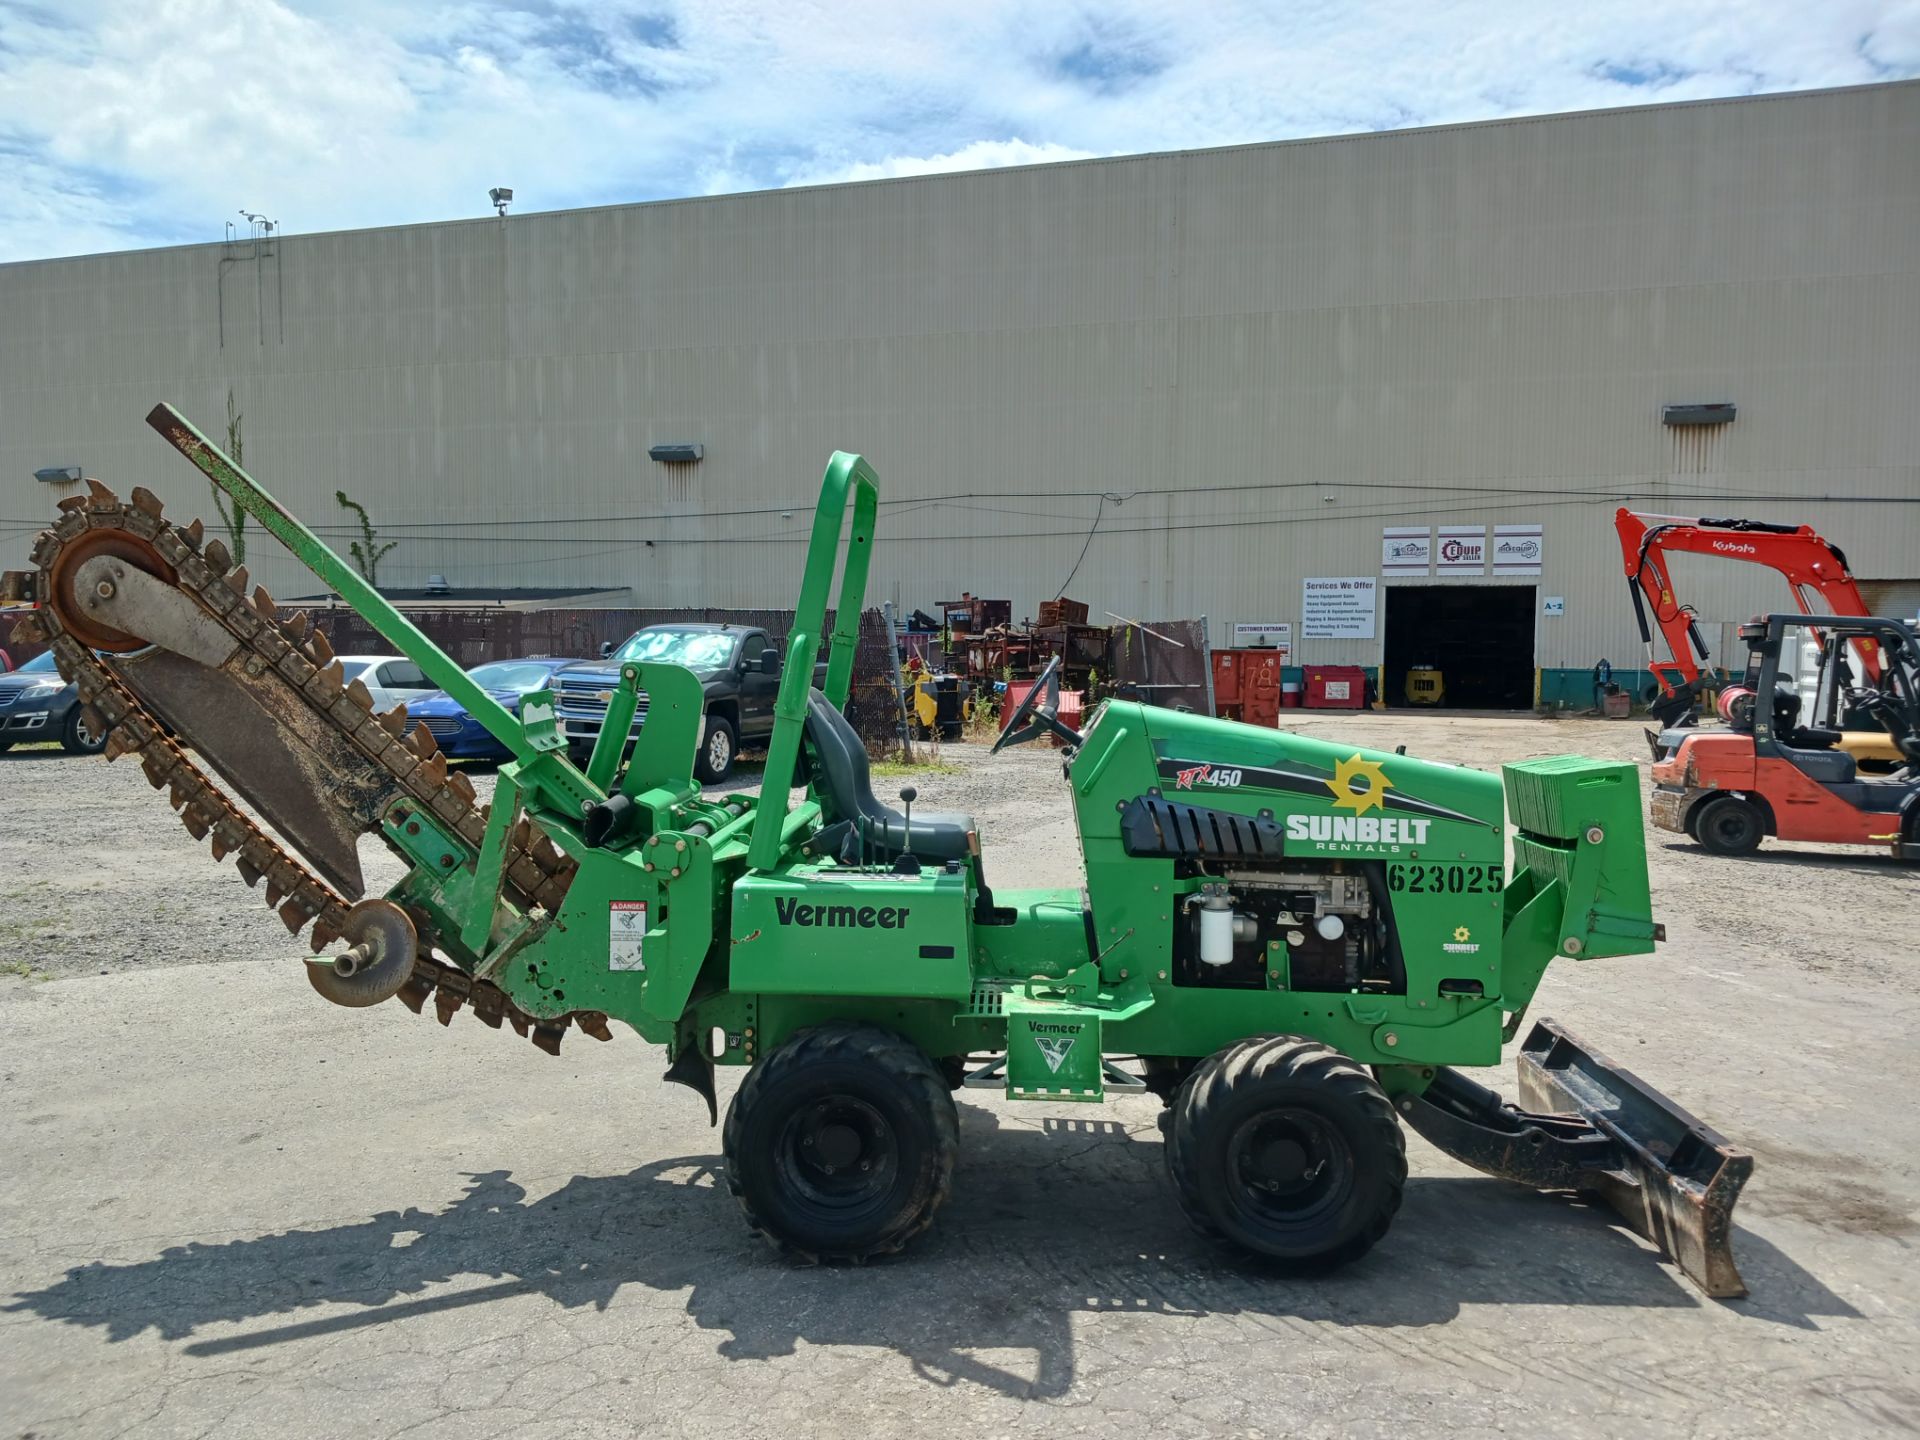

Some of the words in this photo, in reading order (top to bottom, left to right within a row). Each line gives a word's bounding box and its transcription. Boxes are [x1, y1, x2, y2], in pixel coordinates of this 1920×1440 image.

[1450, 545, 1481, 556] EQUIP
[1712, 540, 1756, 554] Kubota
[1306, 582, 1338, 590] Services
[1340, 582, 1352, 590] We
[1354, 581, 1374, 589] Offer
[1544, 602, 1563, 610] A-2
[1286, 814, 1431, 845] SUNBELT
[1316, 843, 1401, 853] RENTALS
[1388, 864, 1504, 894] 623025
[774, 896, 910, 929] Vermeer
[1442, 943, 1480, 951] SUNBELT
[1028, 1021, 1082, 1034] Vermeer
